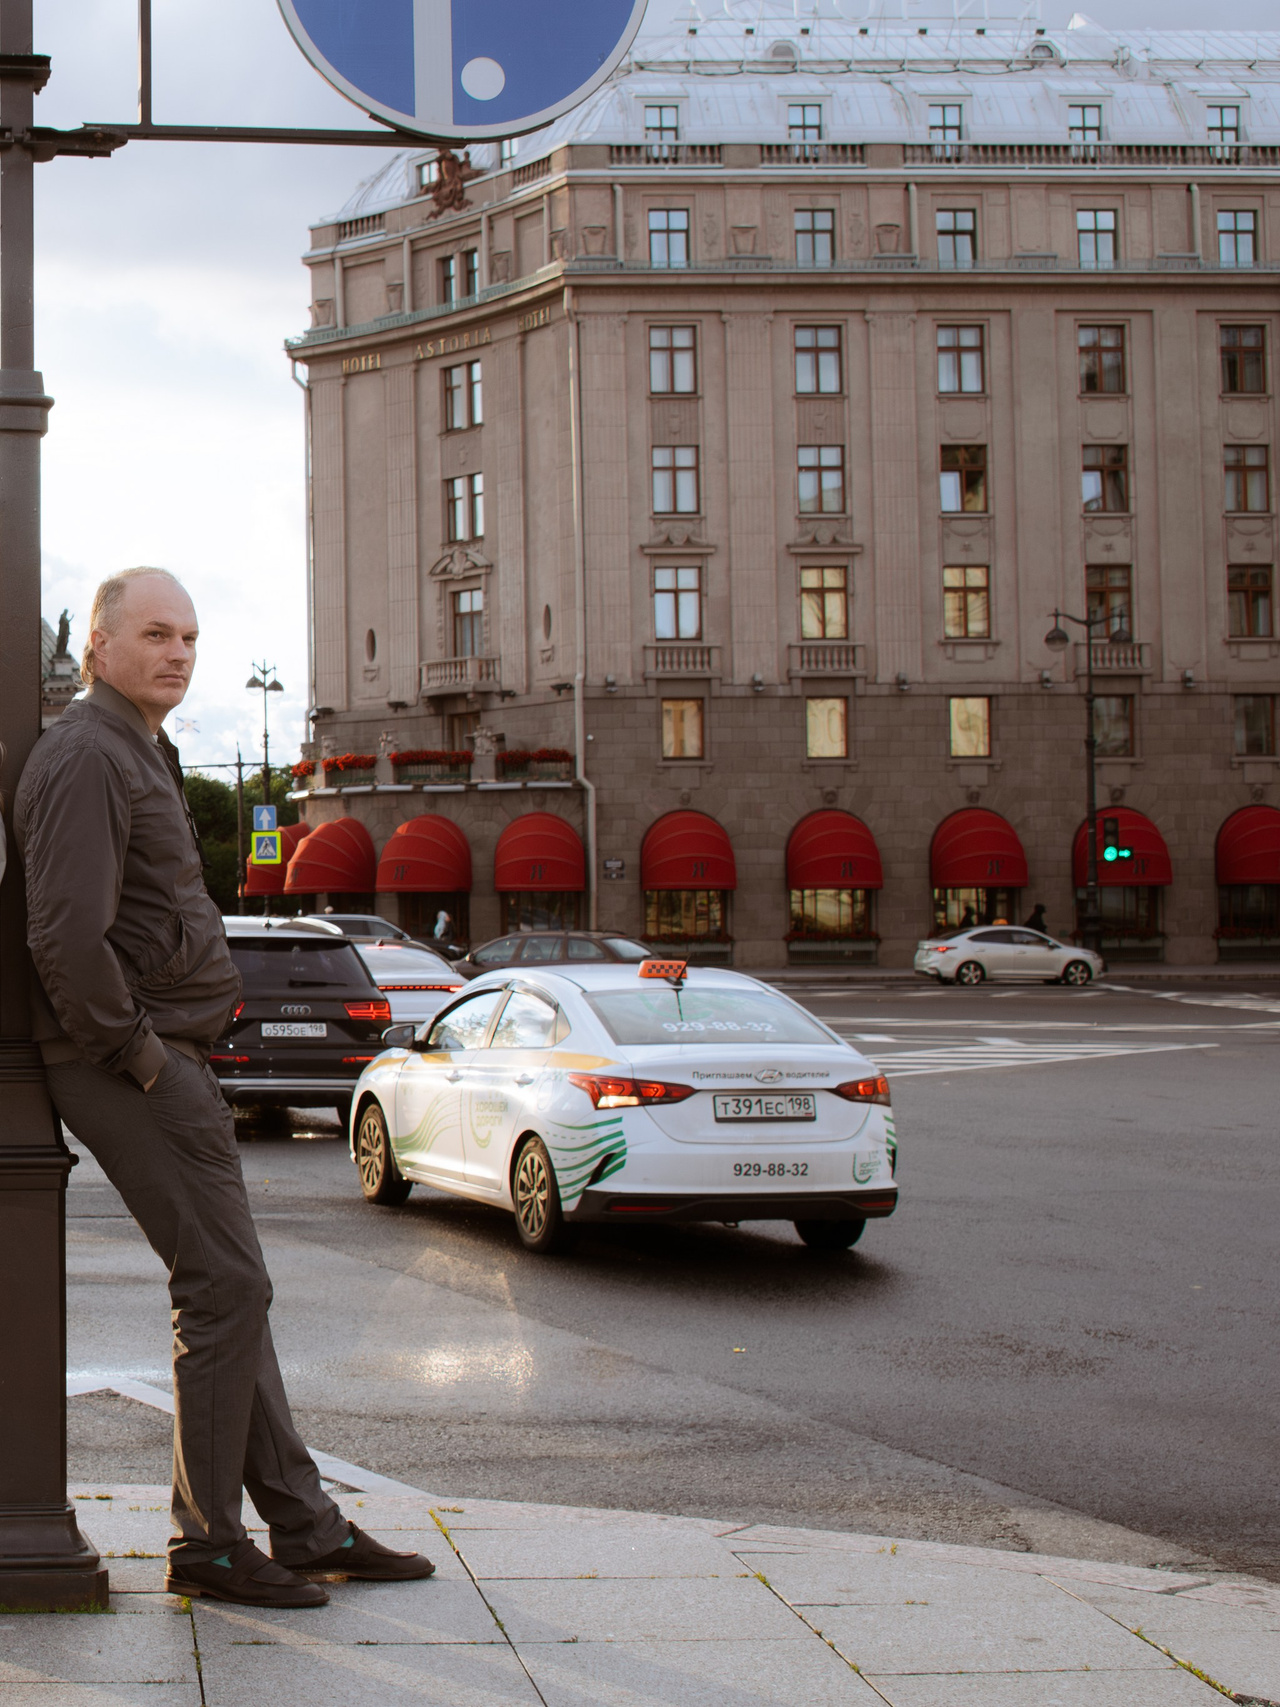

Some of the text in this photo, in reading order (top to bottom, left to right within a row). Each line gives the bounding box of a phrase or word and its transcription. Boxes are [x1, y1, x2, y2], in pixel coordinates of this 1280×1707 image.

[342, 353, 382, 374] HOTEL
[415, 327, 492, 360] ASTORIA
[662, 1021, 777, 1033] 929-88-32
[692, 1070, 830, 1080] Приглашаем водителей
[721, 1097, 811, 1116] Т391ЕС 198
[733, 1162, 809, 1177] 929-88-32
